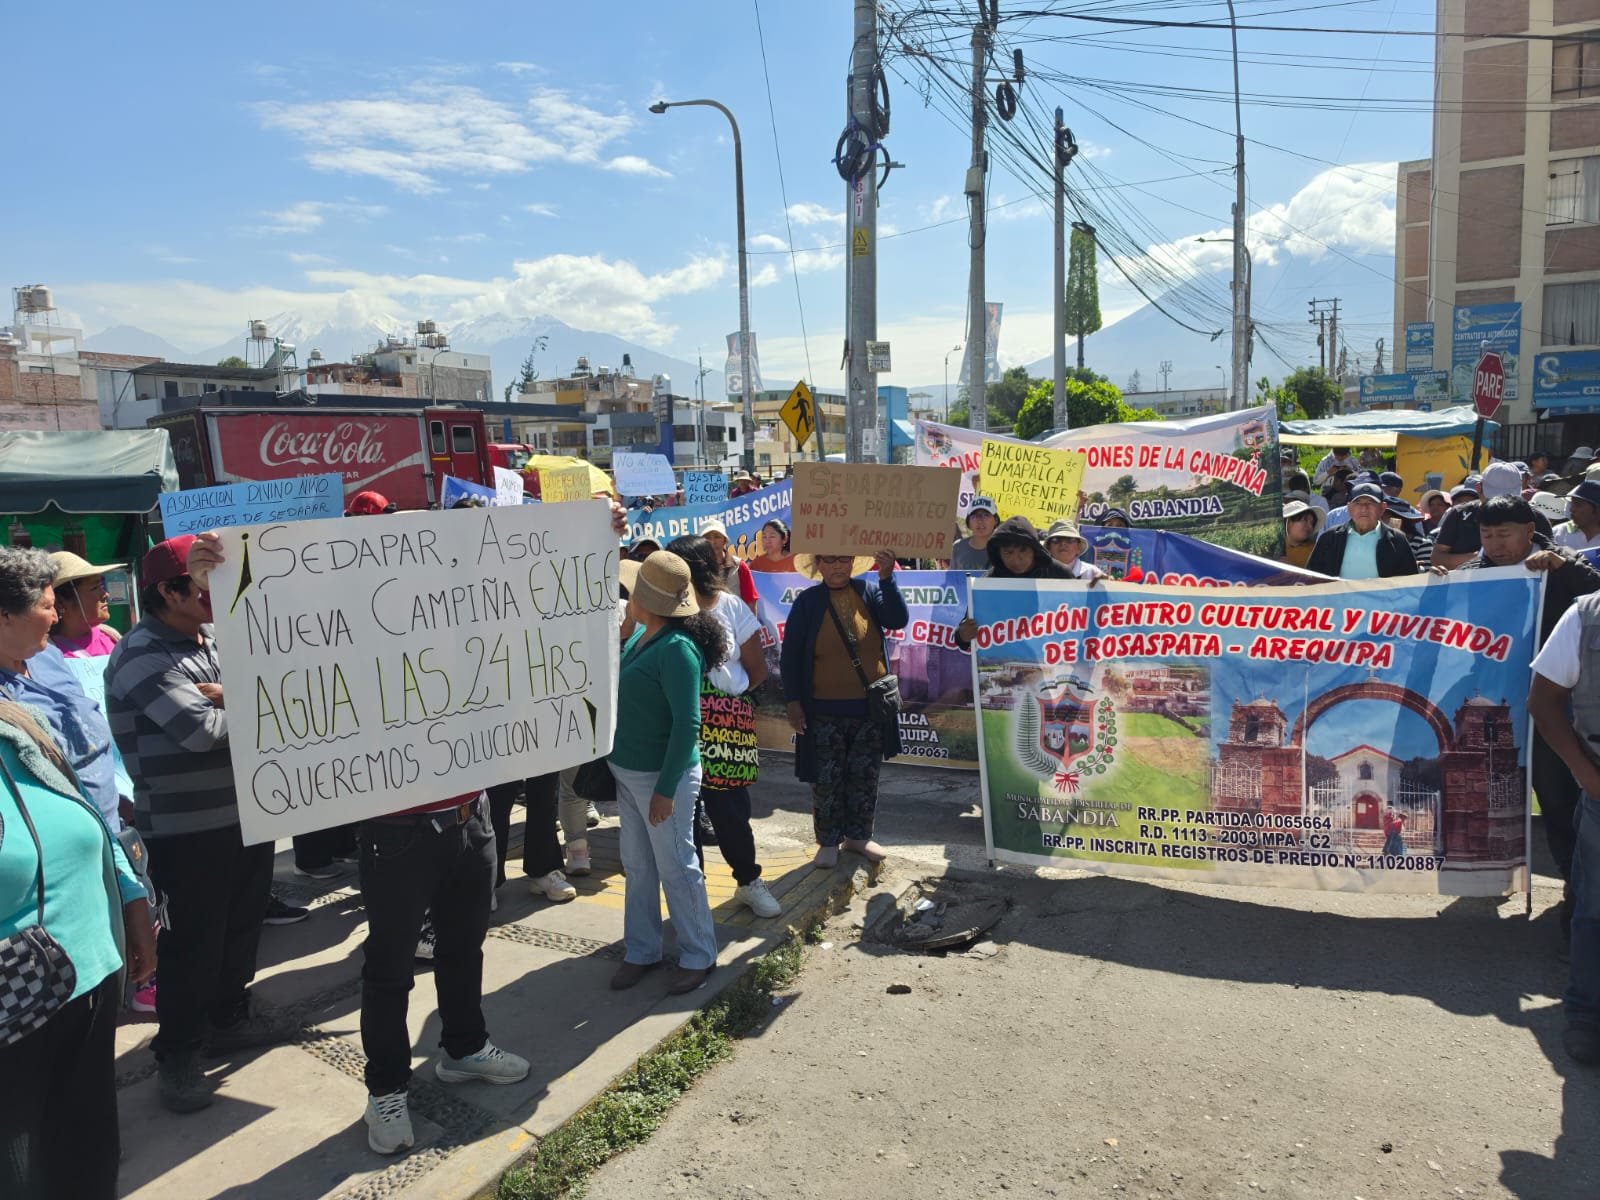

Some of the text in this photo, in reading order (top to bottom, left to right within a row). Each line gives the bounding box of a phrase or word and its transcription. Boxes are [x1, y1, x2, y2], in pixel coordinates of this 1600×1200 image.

[1476, 371, 1503, 400] PARE
[260, 422, 388, 466] Coca-Cola
[987, 460, 1065, 485] UMAPALCA
[1139, 446, 1161, 467] DE
[1164, 448, 1184, 470] LA
[1190, 450, 1266, 494] CAMPIÑA
[1002, 480, 1068, 500] URGENTE
[243, 511, 263, 522] DE
[269, 502, 330, 519] SEDAPAR
[800, 504, 812, 516] NO
[1130, 495, 1223, 518] SABANDIA
[669, 519, 690, 537] DE
[806, 523, 825, 540] NI
[245, 595, 354, 655] NUEVA
[372, 578, 521, 636] CAMPIÑA
[976, 602, 1512, 661] OCIACIÓN CENTRO CULTURAL Y VIVIENDA
[1044, 642, 1077, 665] DE
[1085, 633, 1220, 663] ROSASPATA
[1250, 636, 1393, 668] AREQUIPA
[257, 663, 360, 749] AGUA
[377, 647, 451, 725] LAS
[463, 633, 511, 708] 24
[252, 743, 420, 816] QUEREMOS
[428, 719, 540, 776] SOLUCION
[1018, 803, 1119, 827] SABANDIA
[1137, 806, 1331, 830] RR.PP. PARTIDA 01065664
[1140, 825, 1167, 840] R.D.
[1172, 827, 1207, 842] 1113
[1221, 831, 1258, 846] 2003
[1262, 833, 1296, 847] MPA
[1310, 834, 1331, 849] C2
[1043, 833, 1085, 851] RR.PP.
[1090, 838, 1157, 857] INSCRITA
[1162, 844, 1249, 862] REGISTROS
[1253, 850, 1274, 864] DE
[1279, 851, 1339, 867] PREDIO
[1368, 855, 1444, 871] 11020887
